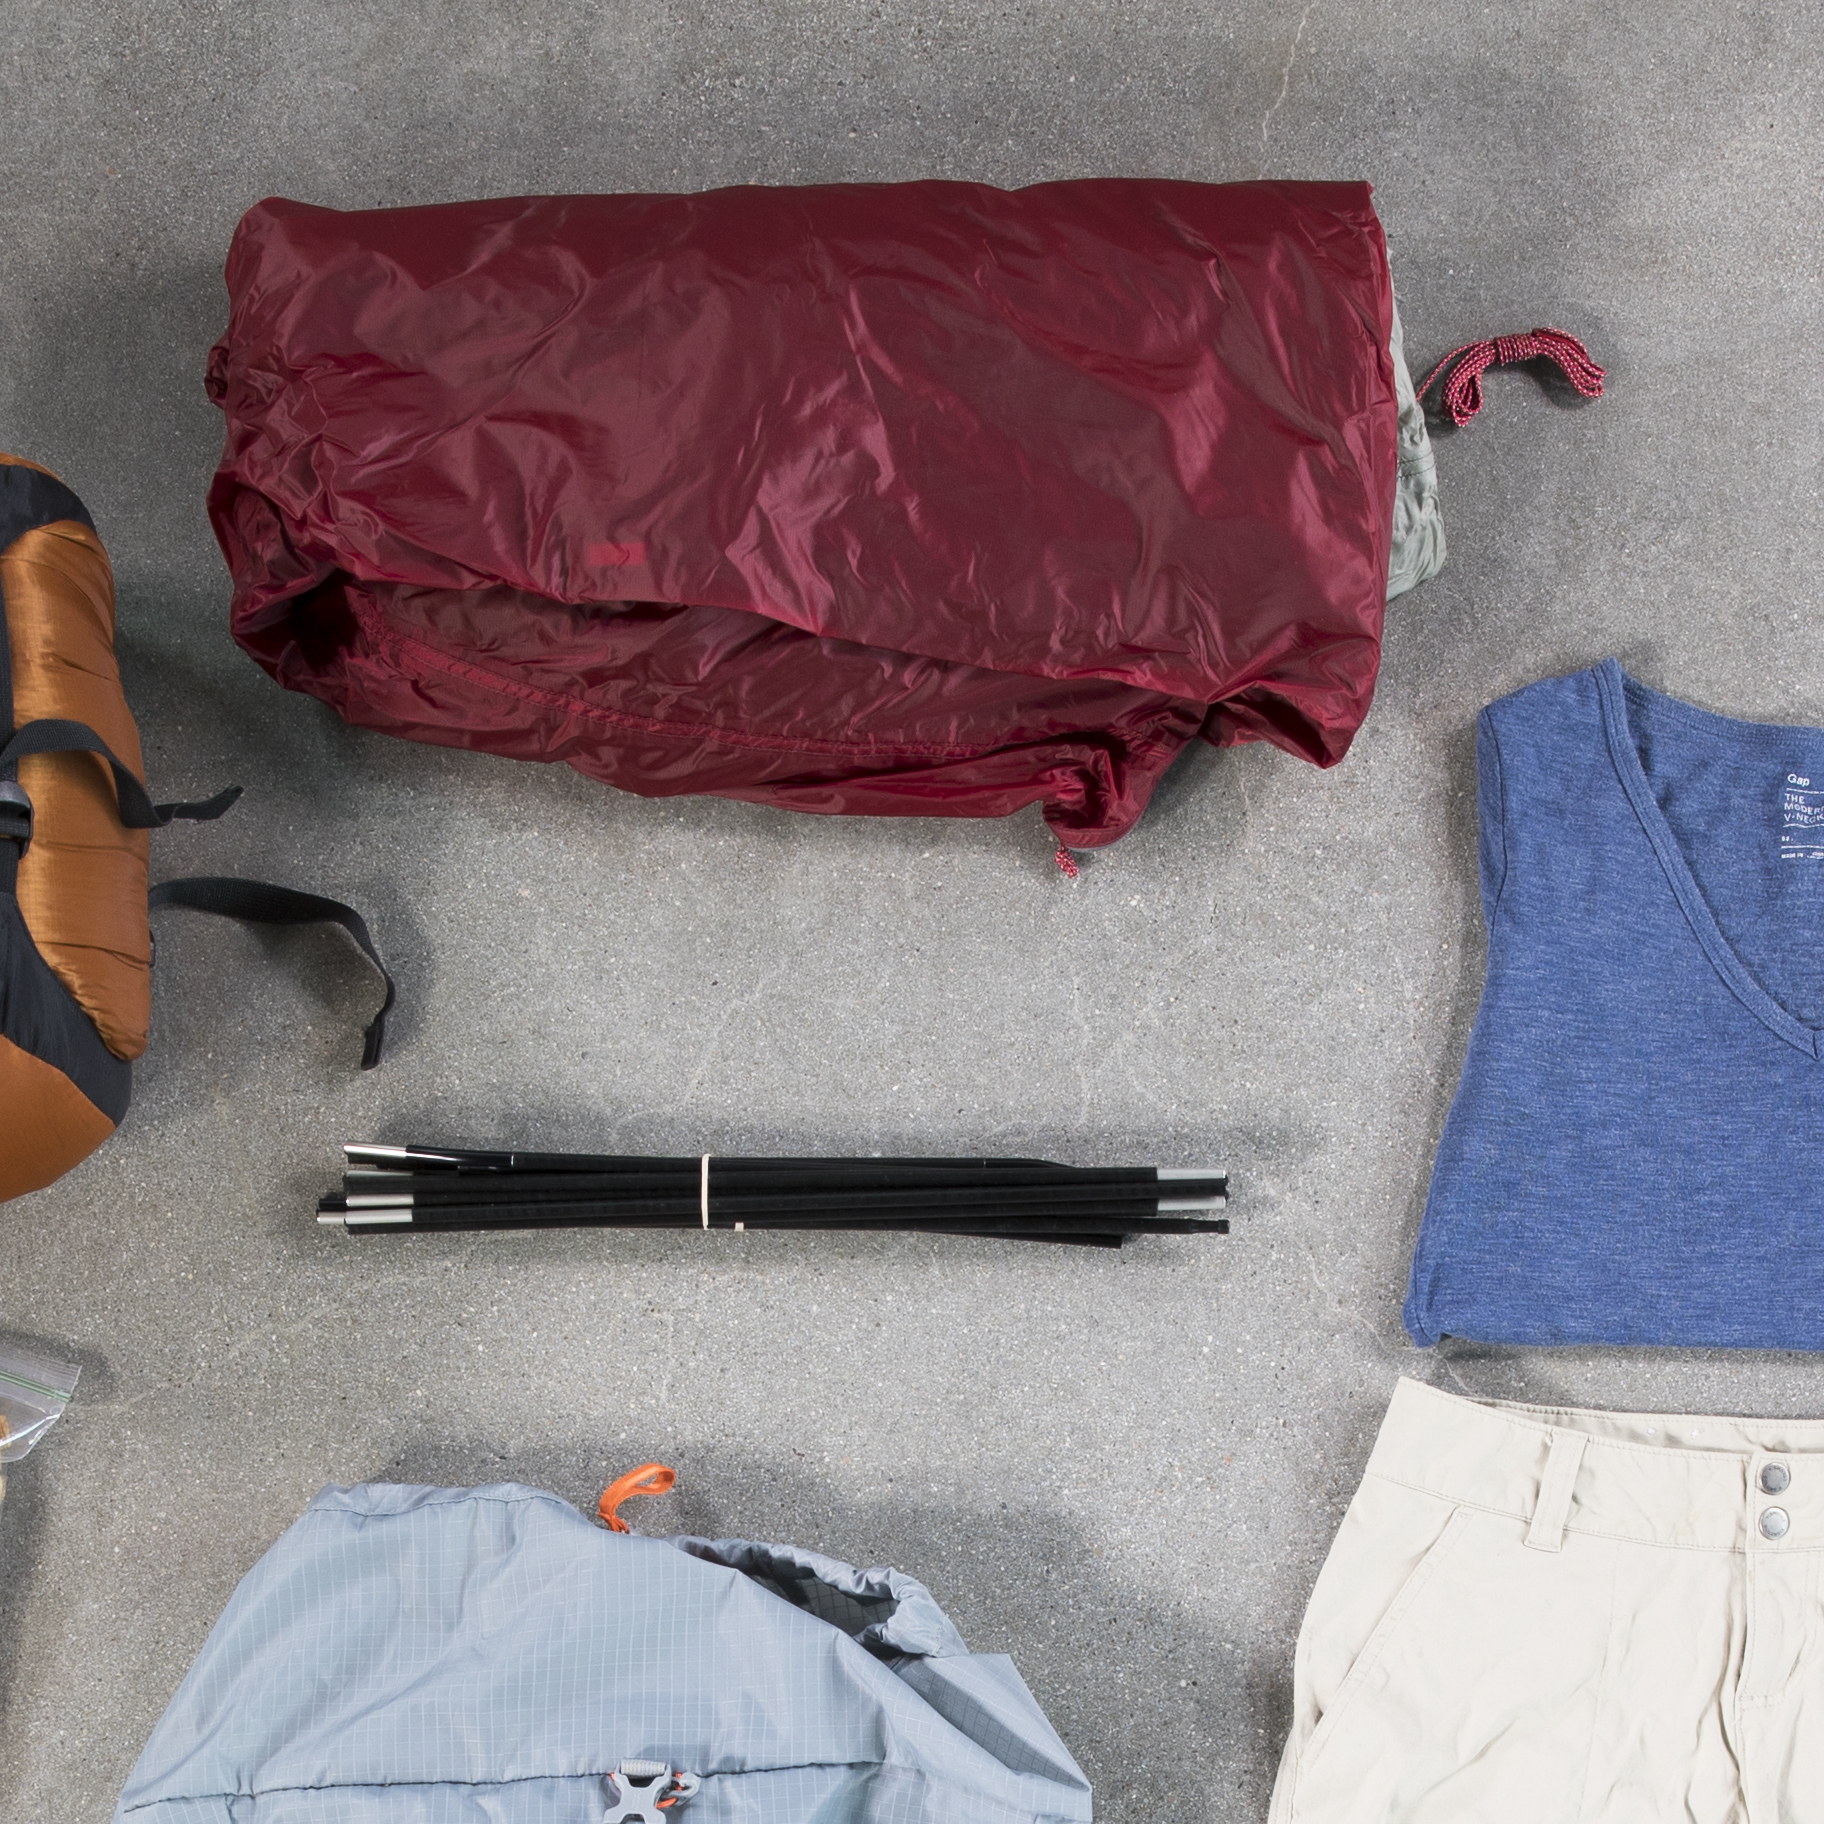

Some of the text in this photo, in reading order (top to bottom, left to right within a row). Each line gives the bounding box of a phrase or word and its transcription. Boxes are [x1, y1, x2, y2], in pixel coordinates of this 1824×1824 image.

[1787, 773, 1810, 787] Gap
[1785, 793, 1805, 804] THE
[1783, 813, 1824, 823] V-NECK
